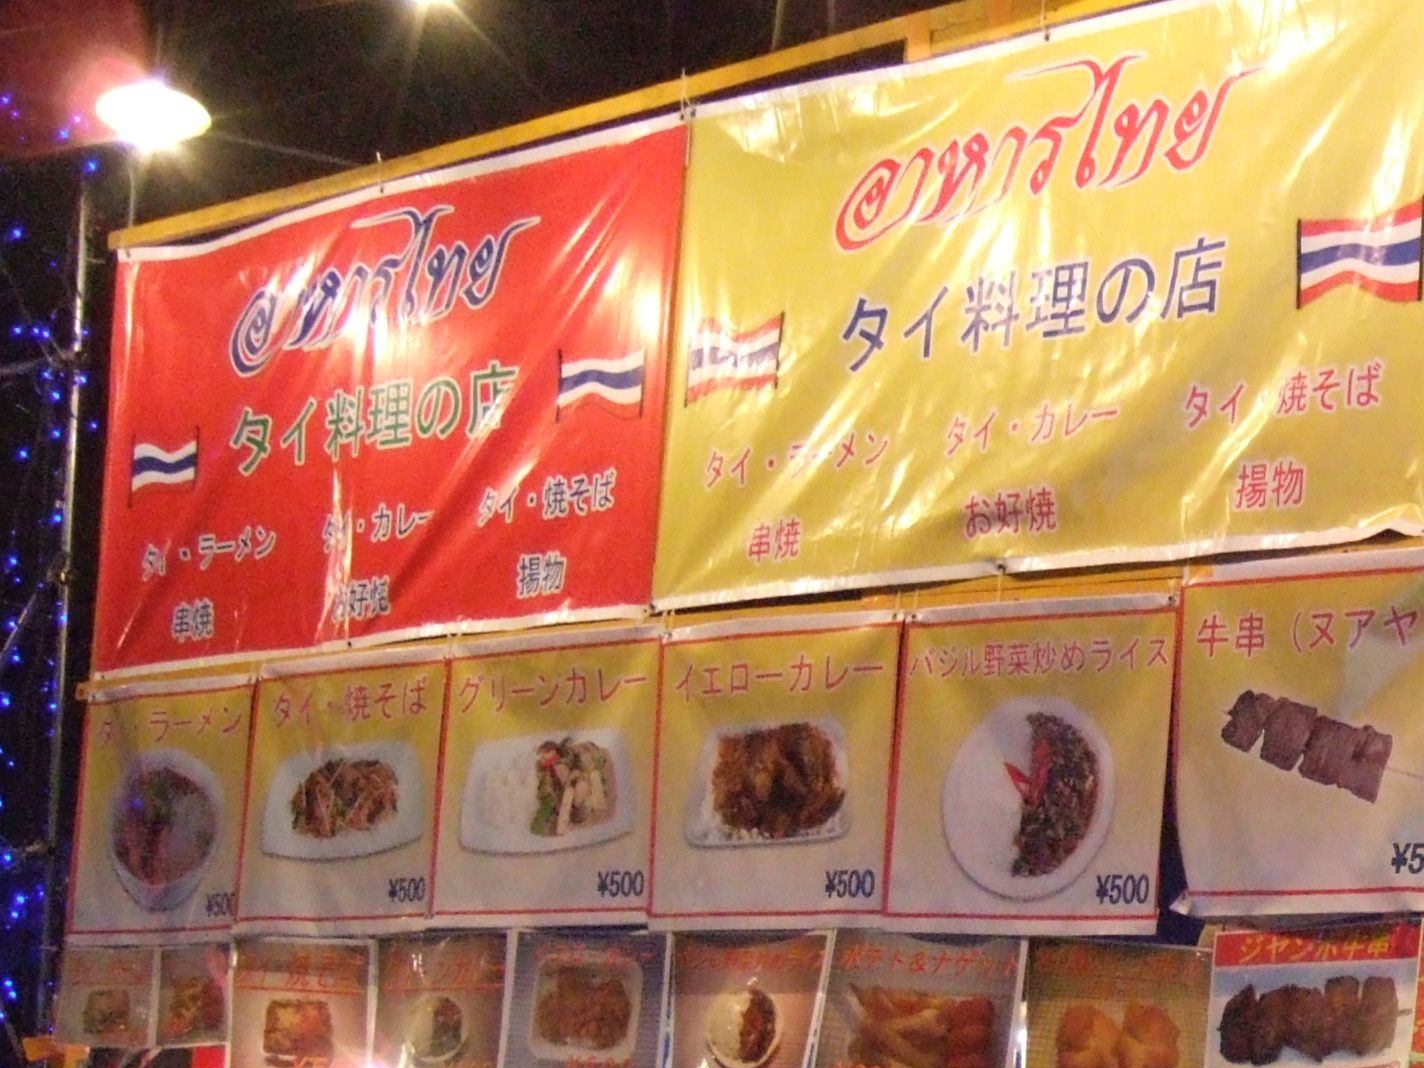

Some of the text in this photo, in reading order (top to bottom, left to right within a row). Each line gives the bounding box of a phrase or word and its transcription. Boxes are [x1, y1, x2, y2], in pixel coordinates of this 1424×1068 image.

[836, 56, 1258, 251] อาหารไทย
[842, 238, 1226, 374] タイ料理の店
[230, 362, 520, 474] タイ料理の店
[946, 404, 1119, 459] タイ・カレー
[477, 469, 617, 527] タイ・焼そば
[747, 463, 1305, 564] 串焼 お好焼 揚物
[171, 599, 214, 642] 串焼
[516, 554, 566, 598] 揚物
[675, 654, 885, 703] イエローカレー
[908, 638, 1170, 681] バジル野菜炒めライス
[457, 668, 648, 716] グリーンカレー
[388, 877, 426, 903] ¥500
[598, 871, 645, 897] ¥500
[824, 869, 875, 899] ¥500
[1097, 874, 1150, 905] ¥500
